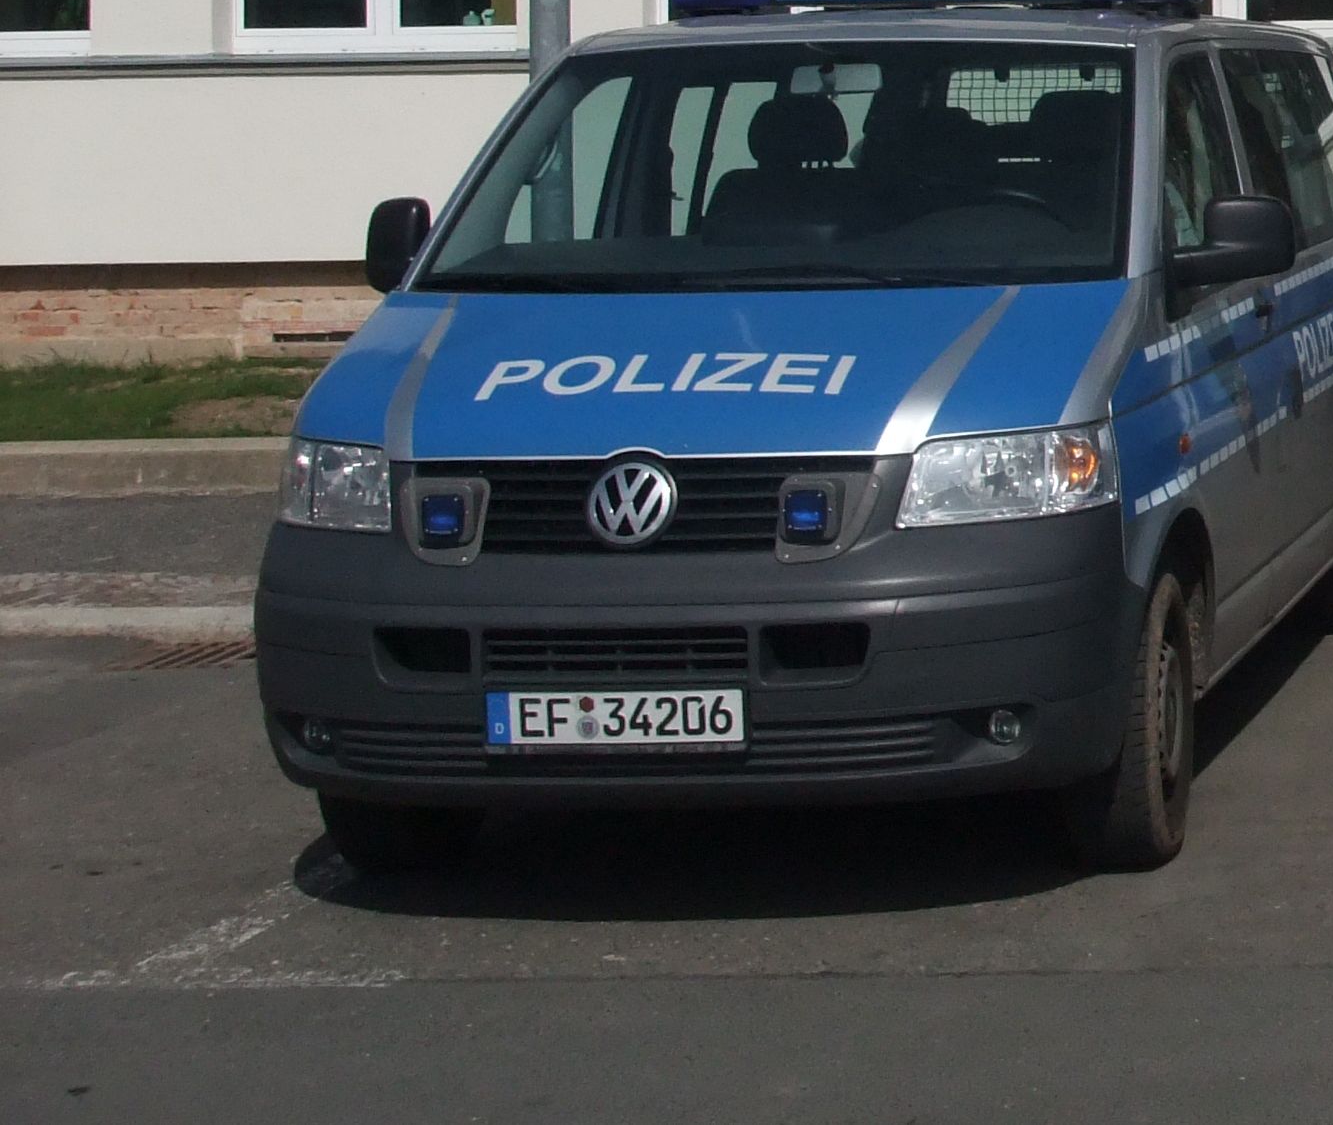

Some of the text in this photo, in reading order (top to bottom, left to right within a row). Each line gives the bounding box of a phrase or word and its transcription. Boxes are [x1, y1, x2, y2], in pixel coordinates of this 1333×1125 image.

[474, 352, 857, 401] POLIZEI
[494, 723, 504, 735] D
[518, 695, 733, 738] EF 34206
